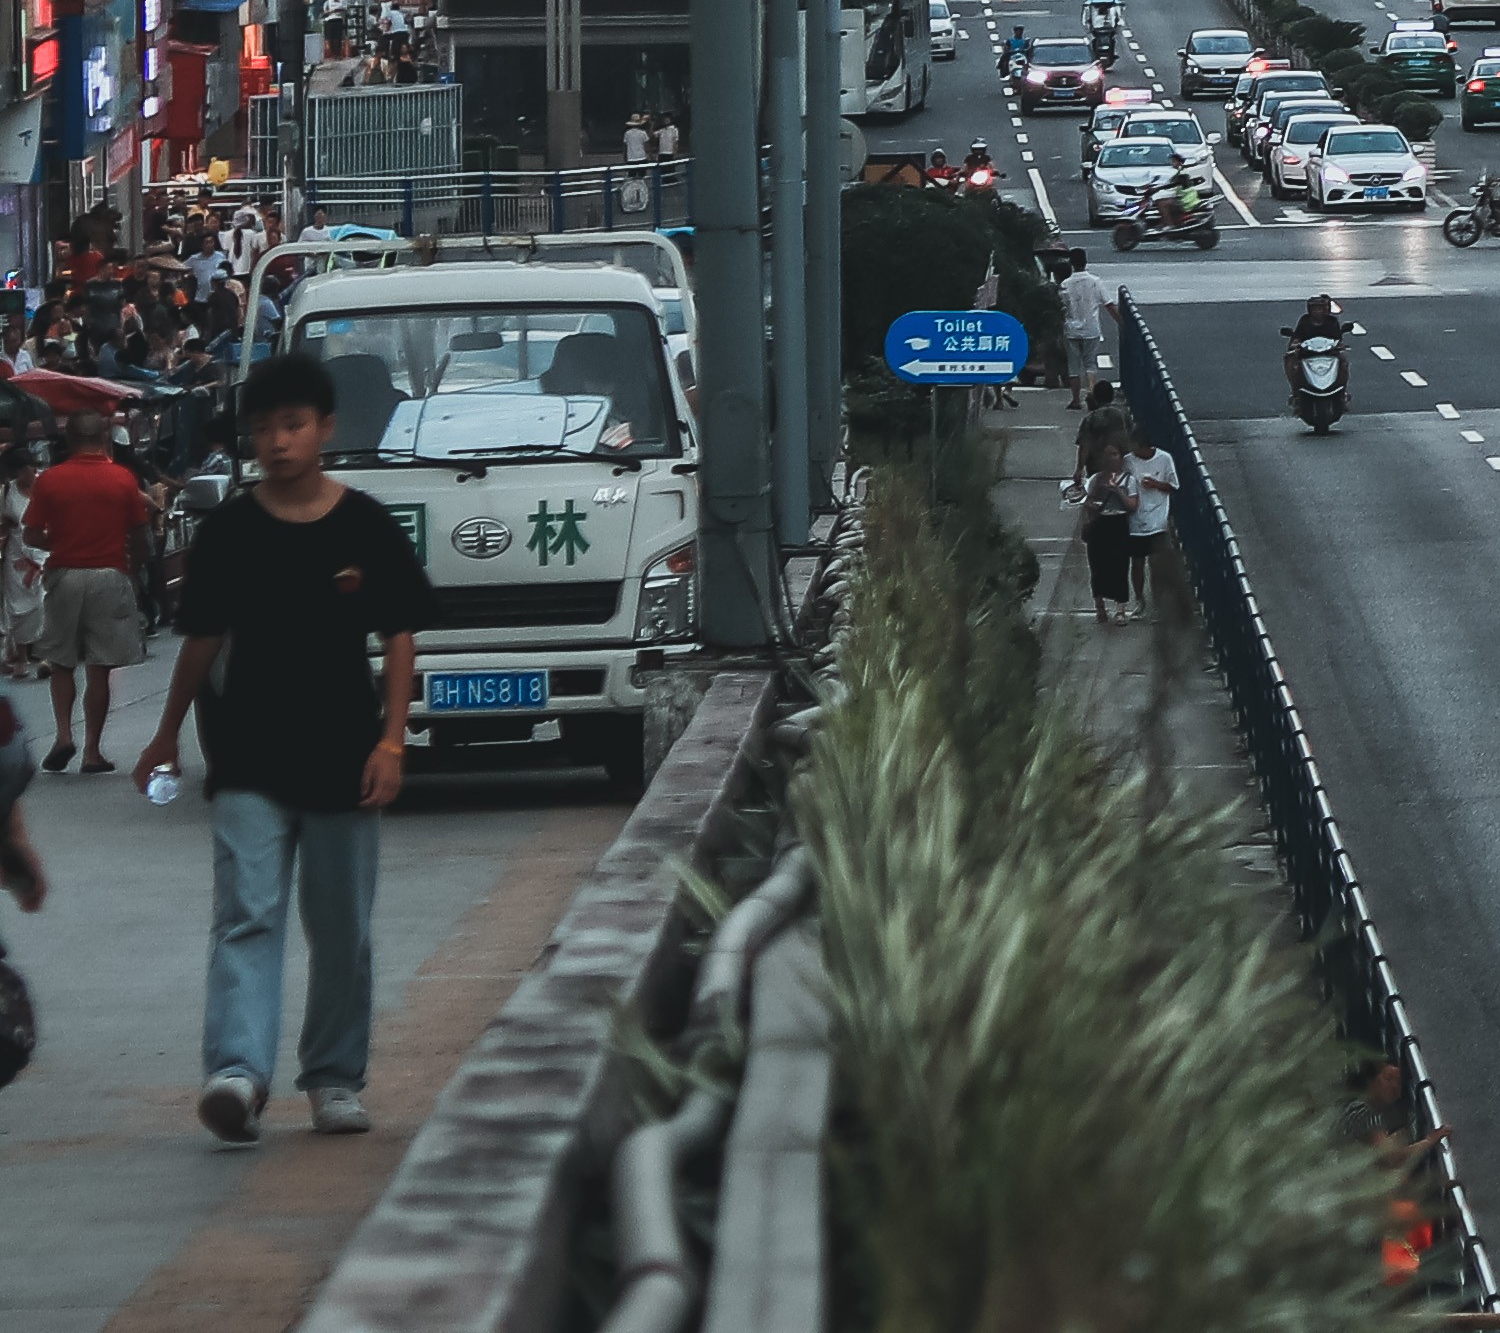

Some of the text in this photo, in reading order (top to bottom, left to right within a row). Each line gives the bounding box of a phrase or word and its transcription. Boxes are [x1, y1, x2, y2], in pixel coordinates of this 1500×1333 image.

[934, 318, 983, 333] Toilet
[943, 335, 1011, 352] 公共厕所
[525, 499, 591, 567] 林
